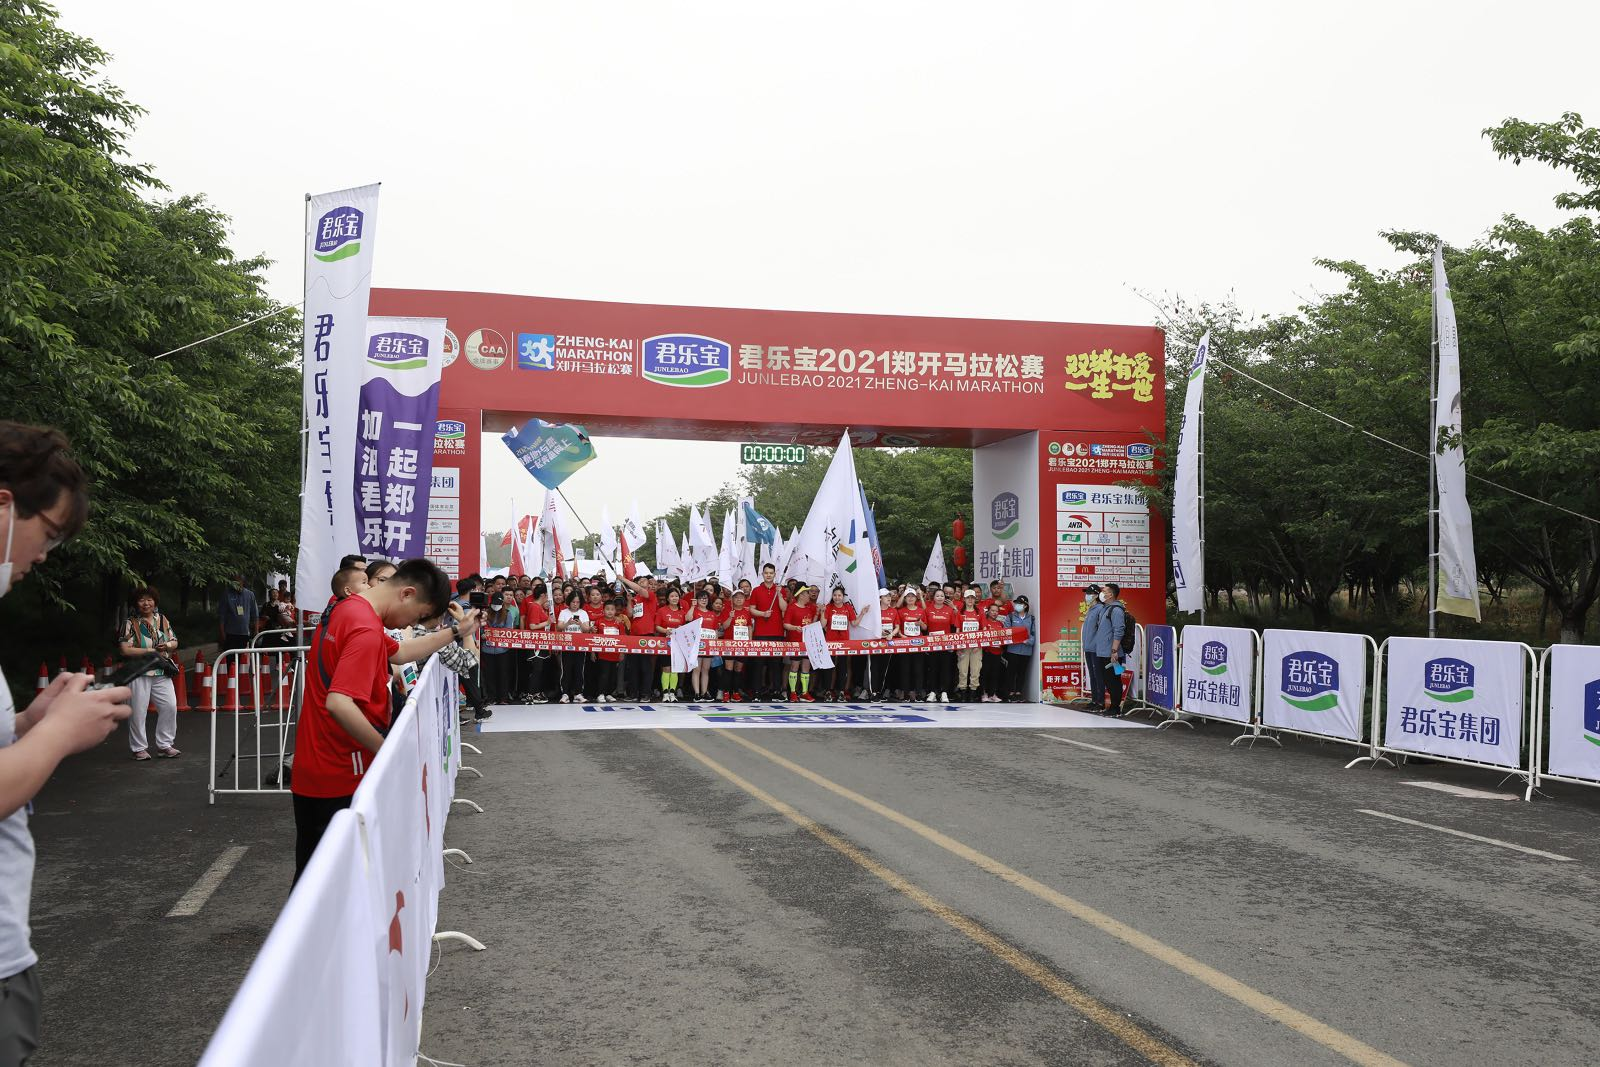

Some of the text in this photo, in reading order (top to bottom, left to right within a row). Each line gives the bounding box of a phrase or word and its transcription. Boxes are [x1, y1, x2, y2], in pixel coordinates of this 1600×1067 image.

[322, 213, 359, 240] 君乐宝
[375, 336, 423, 356] 君乐宝
[480, 345, 505, 355] CAA
[555, 335, 633, 350] ZHENG-KAI
[555, 348, 633, 363] MARATHON
[655, 342, 721, 367] 君乐宝
[738, 344, 1044, 379] 君乐宝2021郑开马拉松赛
[555, 360, 633, 375] 郑开马拉松赛
[654, 366, 689, 374] JUNLEBAO
[1064, 348, 1156, 381] 双城有爱
[738, 371, 1044, 394] JUNLEBAO 2021 ZHENG-KAI MARATHON
[1064, 372, 1154, 402] 一生一世
[437, 422, 462, 432] 君乐宝
[743, 445, 805, 463] 00:00:00
[1131, 445, 1151, 454] 君乐宝
[1048, 457, 1154, 469] 君乐宝2021郑开马拉松赛
[1065, 491, 1084, 500] 君乐宝
[1091, 492, 1145, 505] 君乐宝集团
[994, 497, 1016, 520] 君乐宝
[1068, 521, 1083, 529] ANTA
[1204, 645, 1225, 662] 君乐宝
[1046, 672, 1080, 686] 距开赛 5
[1288, 658, 1333, 686] 君乐宝
[1430, 663, 1469, 684] 君乐宝
[1187, 678, 1241, 707] 君乐宝集团
[1287, 684, 1312, 693] JUNLEBAO
[1400, 706, 1500, 746] 君乐宝集团
